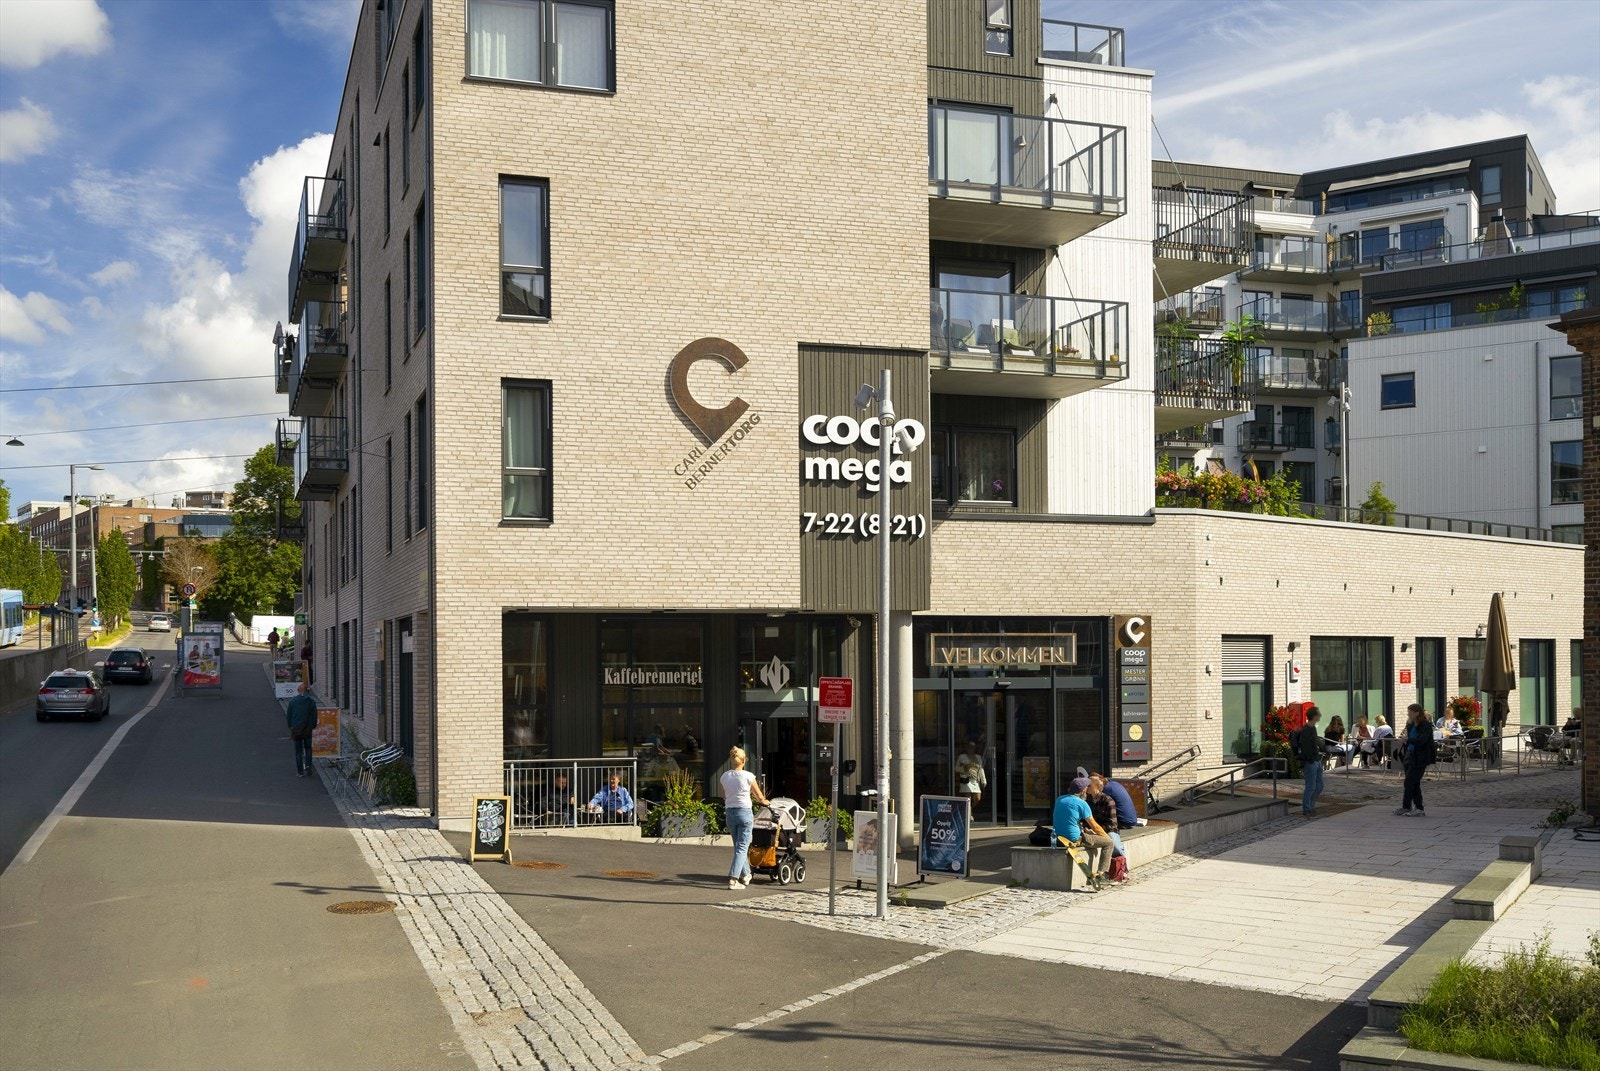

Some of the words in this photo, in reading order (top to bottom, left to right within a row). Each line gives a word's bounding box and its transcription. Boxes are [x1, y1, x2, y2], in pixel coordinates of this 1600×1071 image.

[803, 414, 926, 455] coop
[674, 447, 707, 476] CARL
[685, 413, 761, 490] BERNERTORG
[805, 457, 912, 492] mega
[803, 512, 855, 534] 7-22
[941, 647, 1065, 664] VELKOMMEN
[604, 667, 704, 685] Kaffebrenneriet
[931, 828, 957, 841] 50%
